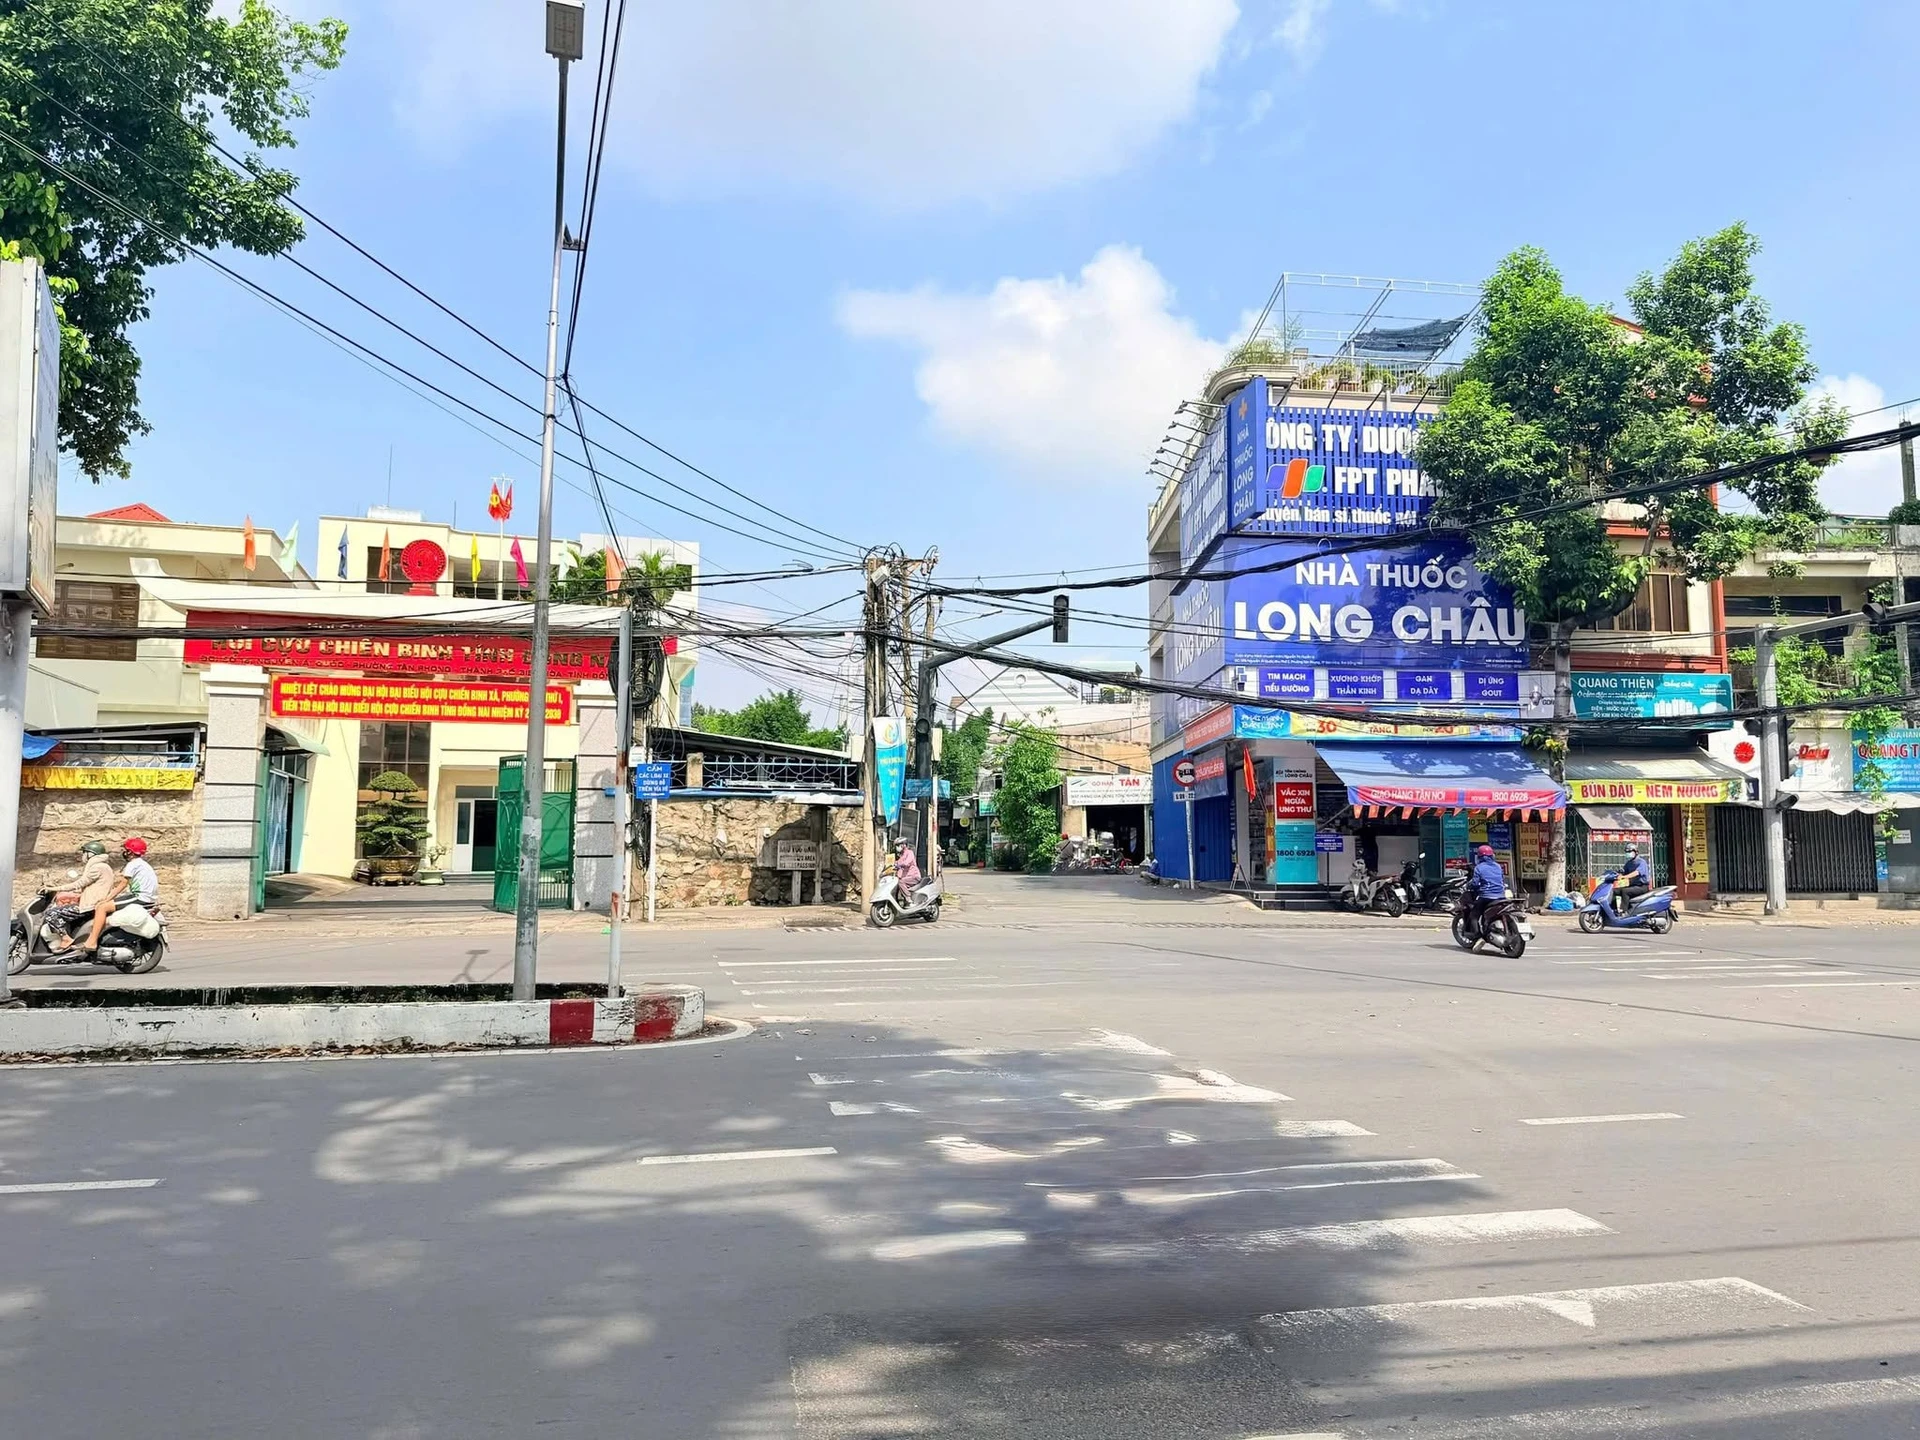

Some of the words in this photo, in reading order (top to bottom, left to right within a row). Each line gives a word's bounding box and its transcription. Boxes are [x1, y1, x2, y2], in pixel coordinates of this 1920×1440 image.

[1236, 423, 1250, 445] NHÀ
[1266, 417, 1314, 451] ÔNG
[1322, 424, 1353, 453] TY
[1232, 466, 1254, 495] LONG
[1334, 467, 1378, 495] FPT
[1387, 469, 1444, 497] PHA
[1232, 491, 1255, 517] CHÂU
[1258, 506, 1300, 523] uyên
[1304, 506, 1330, 523] bán
[1353, 503, 1391, 525] thuốc
[1296, 554, 1359, 586] NHÀ
[1366, 554, 1467, 589] THUỐC
[1234, 601, 1374, 643] LONG
[1391, 597, 1525, 645] CHÂU
[398, 643, 453, 660] BINH
[1268, 673, 1280, 681] TIM
[1282, 673, 1306, 682] MẠCH
[1330, 675, 1358, 683] XƯƠNG
[1478, 677, 1487, 686] DỊ
[1488, 676, 1504, 685] ỨNG
[1578, 678, 1617, 690] QUANG
[1621, 676, 1654, 690] THIỆN
[1281, 684, 1310, 693] ĐƯỜNG
[1336, 685, 1356, 695] THẦN
[1358, 687, 1377, 695] KINH
[1410, 687, 1421, 695] DẠ
[1423, 686, 1439, 695] DÀY
[1482, 689, 1502, 697] GOUT
[471, 690, 488, 701] BINH
[422, 705, 440, 716] BINH
[478, 706, 490, 717] NAI
[1318, 721, 1337, 734] 30
[123, 773, 155, 786] ANH
[1119, 776, 1140, 787] TÂN
[1391, 788, 1414, 800] HÀNG
[1492, 791, 1508, 802] 1800
[1510, 791, 1528, 802] 6928
[1581, 782, 1606, 798] BÚN
[1609, 782, 1633, 801] ĐẬU
[1646, 785, 1673, 798] NEM
[1296, 805, 1313, 813] THƯ
[1276, 849, 1294, 857] 1800
[1296, 849, 1315, 857] 6928
